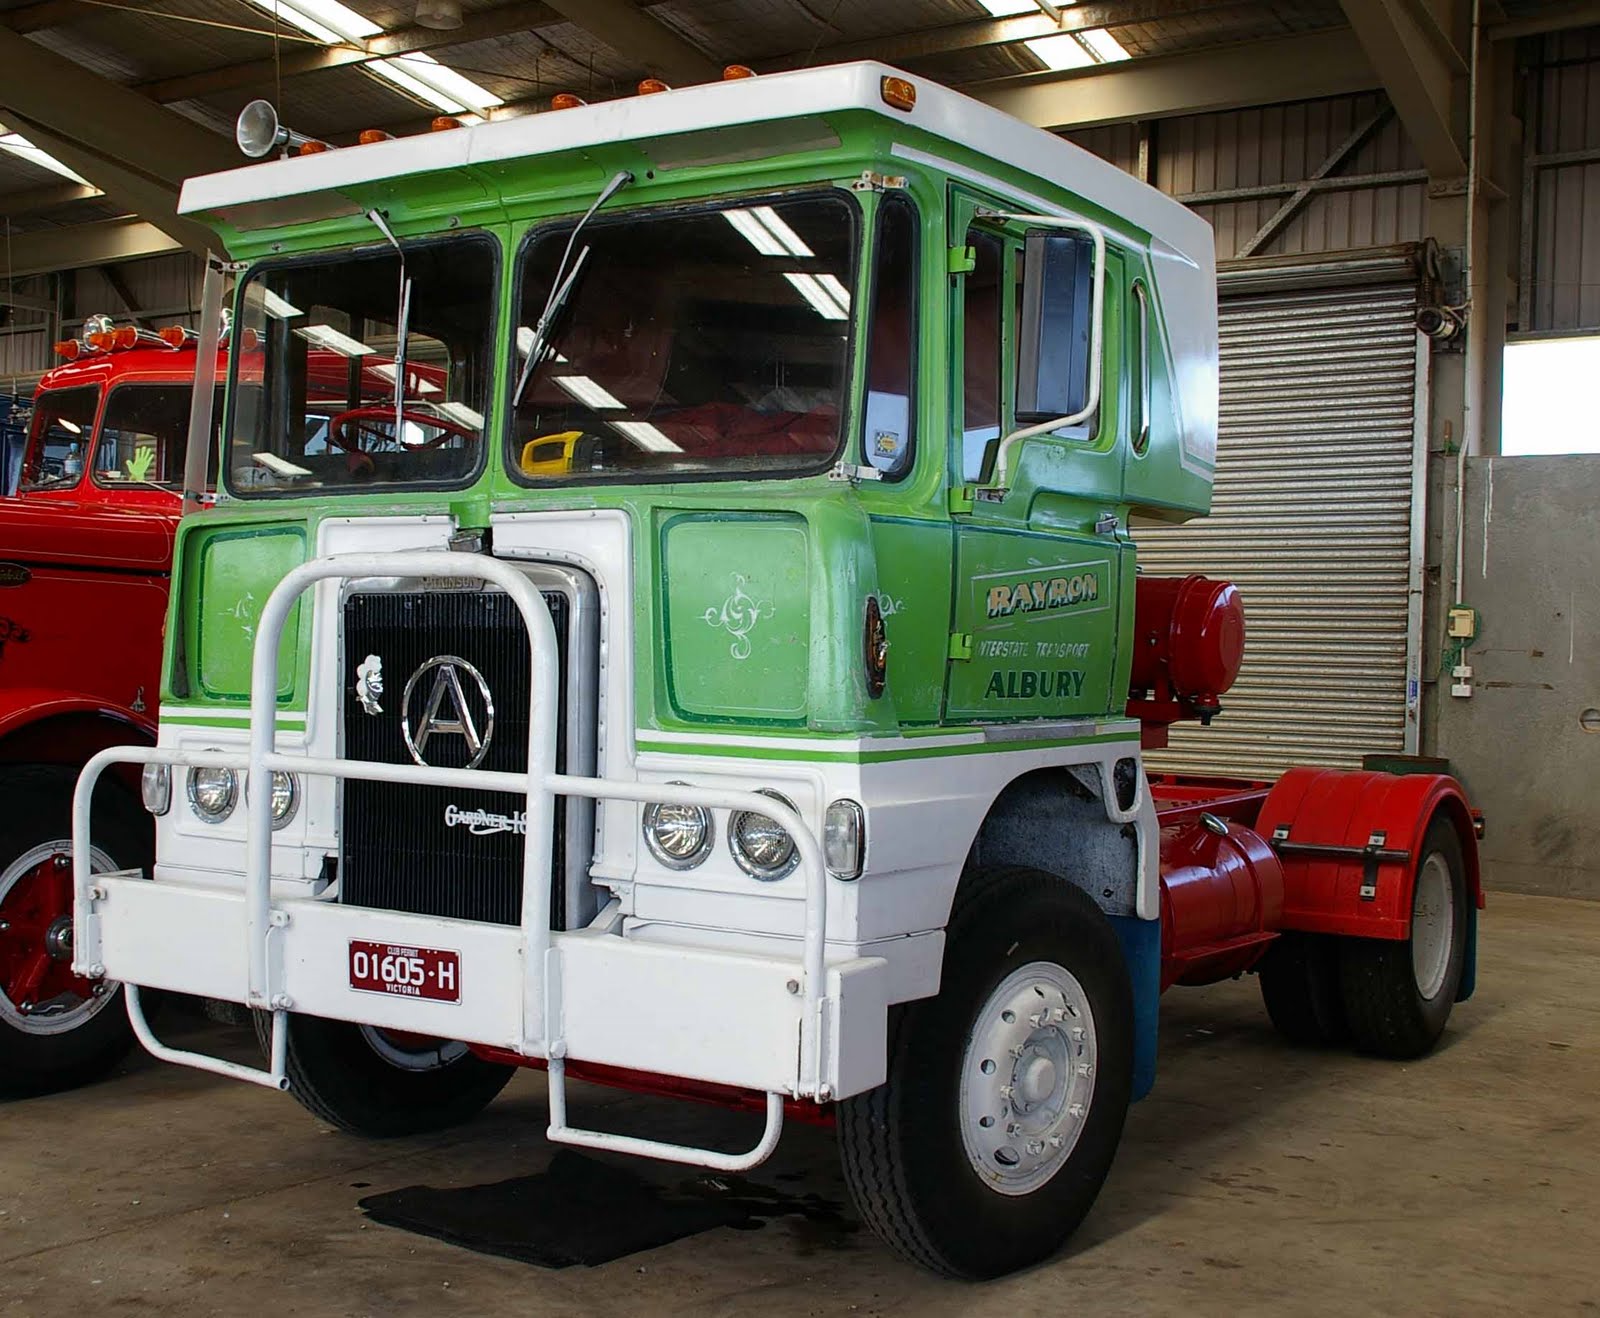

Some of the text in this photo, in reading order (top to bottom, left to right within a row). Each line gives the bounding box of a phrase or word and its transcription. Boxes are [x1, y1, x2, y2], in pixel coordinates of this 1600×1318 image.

[987, 574, 1099, 618] RAYRON
[985, 671, 1086, 698] ALBURY
[386, 983, 420, 995] VICTORIA
